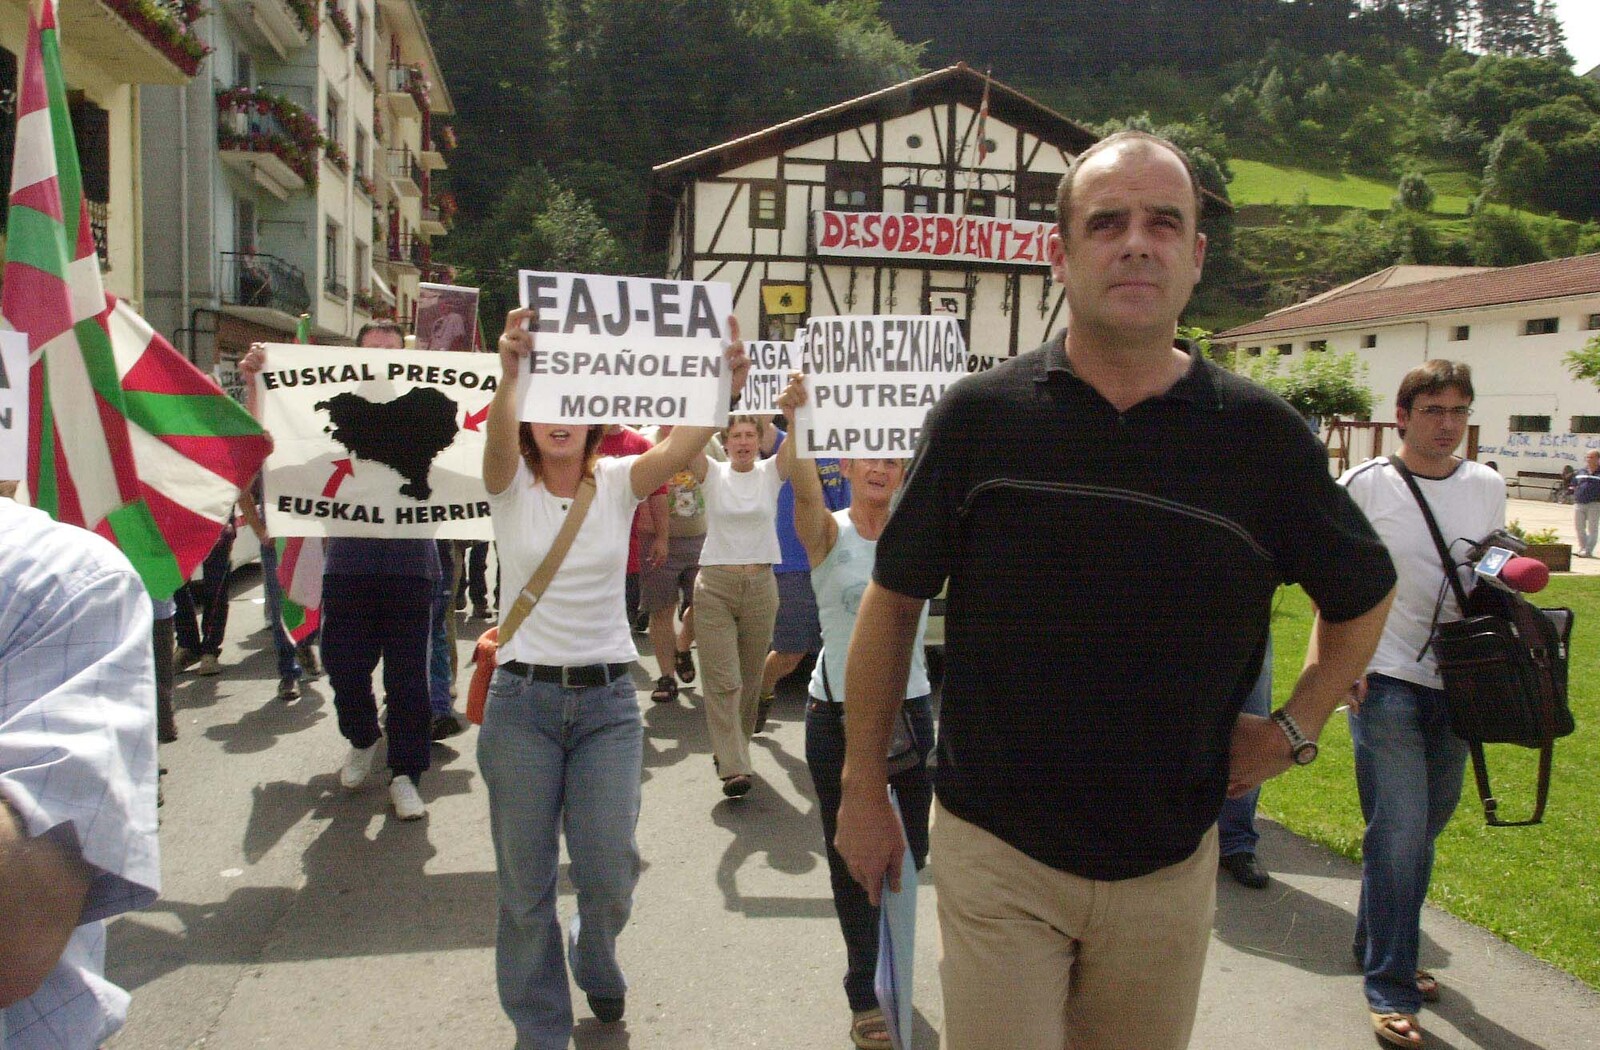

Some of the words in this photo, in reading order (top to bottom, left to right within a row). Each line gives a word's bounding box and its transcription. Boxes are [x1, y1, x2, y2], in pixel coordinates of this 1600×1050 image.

[527, 275, 721, 338] EAJ-EA
[262, 363, 375, 391] EUSKAL
[387, 363, 497, 393] PRESOA
[530, 349, 721, 378] ESPAÑOLEN
[560, 395, 688, 418] MORROI
[278, 495, 385, 524] EUSKAL
[396, 501, 492, 525] HERRIR
